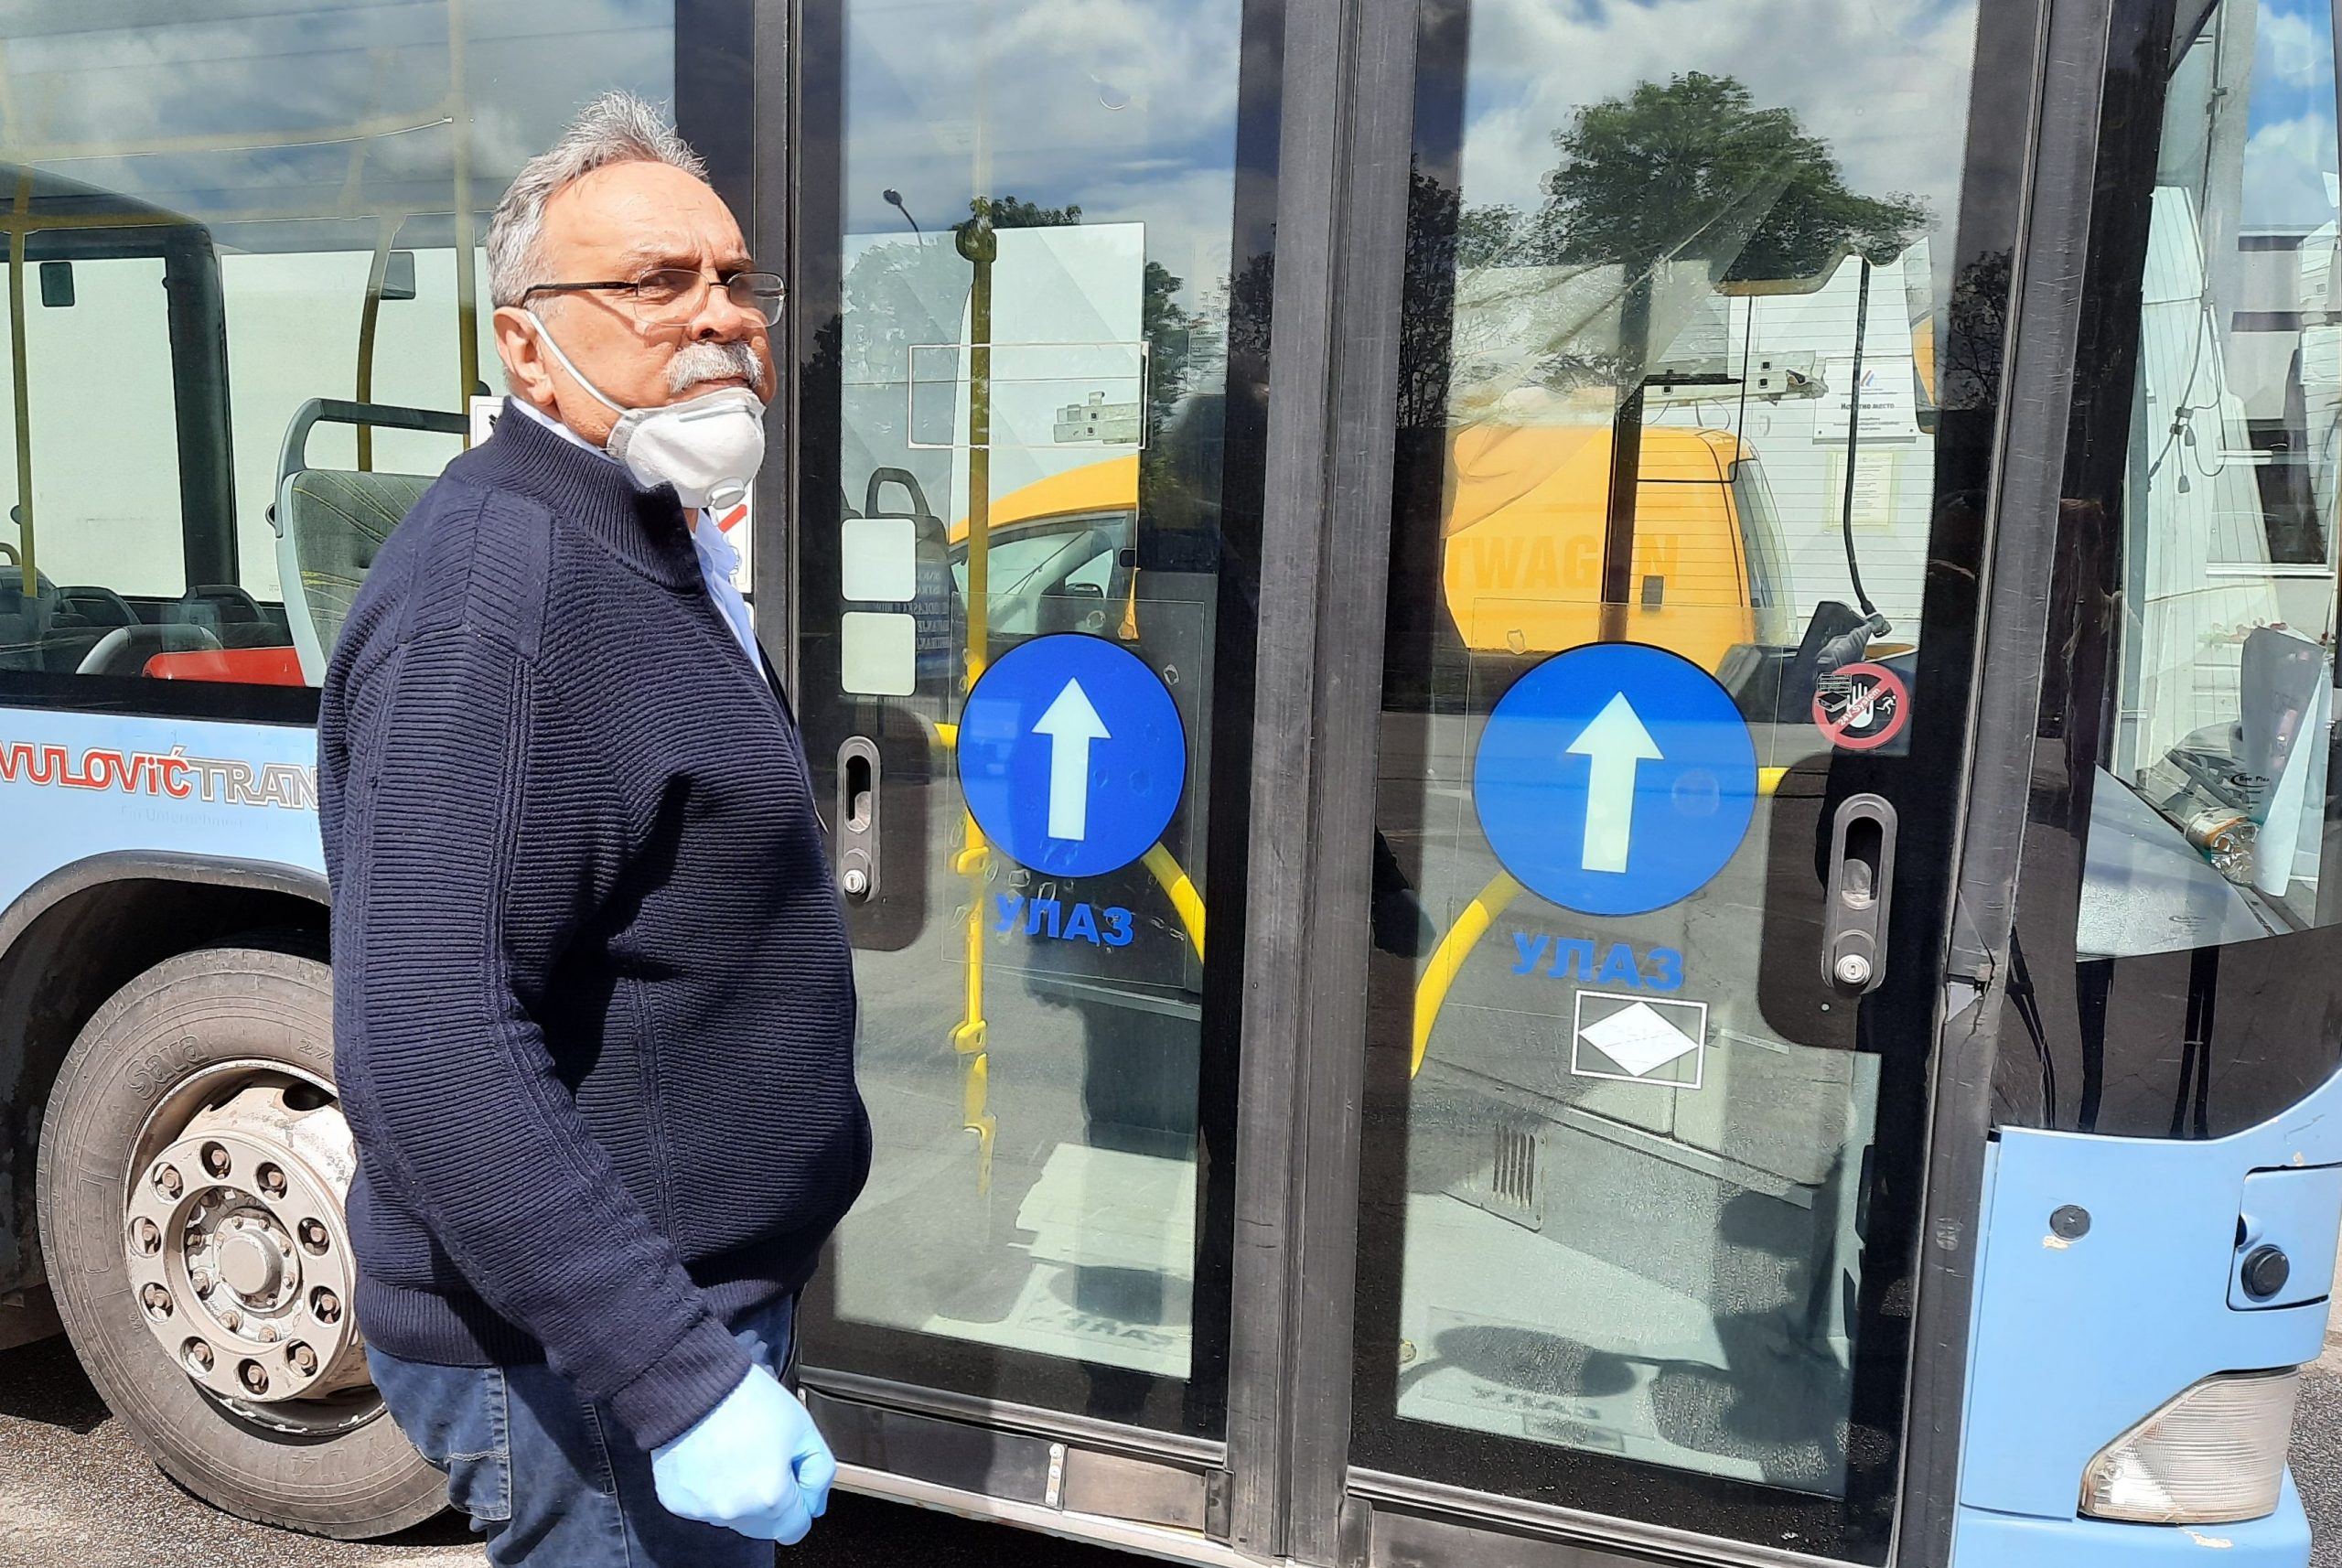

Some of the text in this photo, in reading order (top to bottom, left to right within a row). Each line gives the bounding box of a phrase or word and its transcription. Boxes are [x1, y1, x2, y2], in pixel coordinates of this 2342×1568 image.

[1447, 534, 1679, 589] TWAGN
[995, 894, 1134, 946] УЛАЗ
[1512, 931, 1684, 992] УЛАЗ
